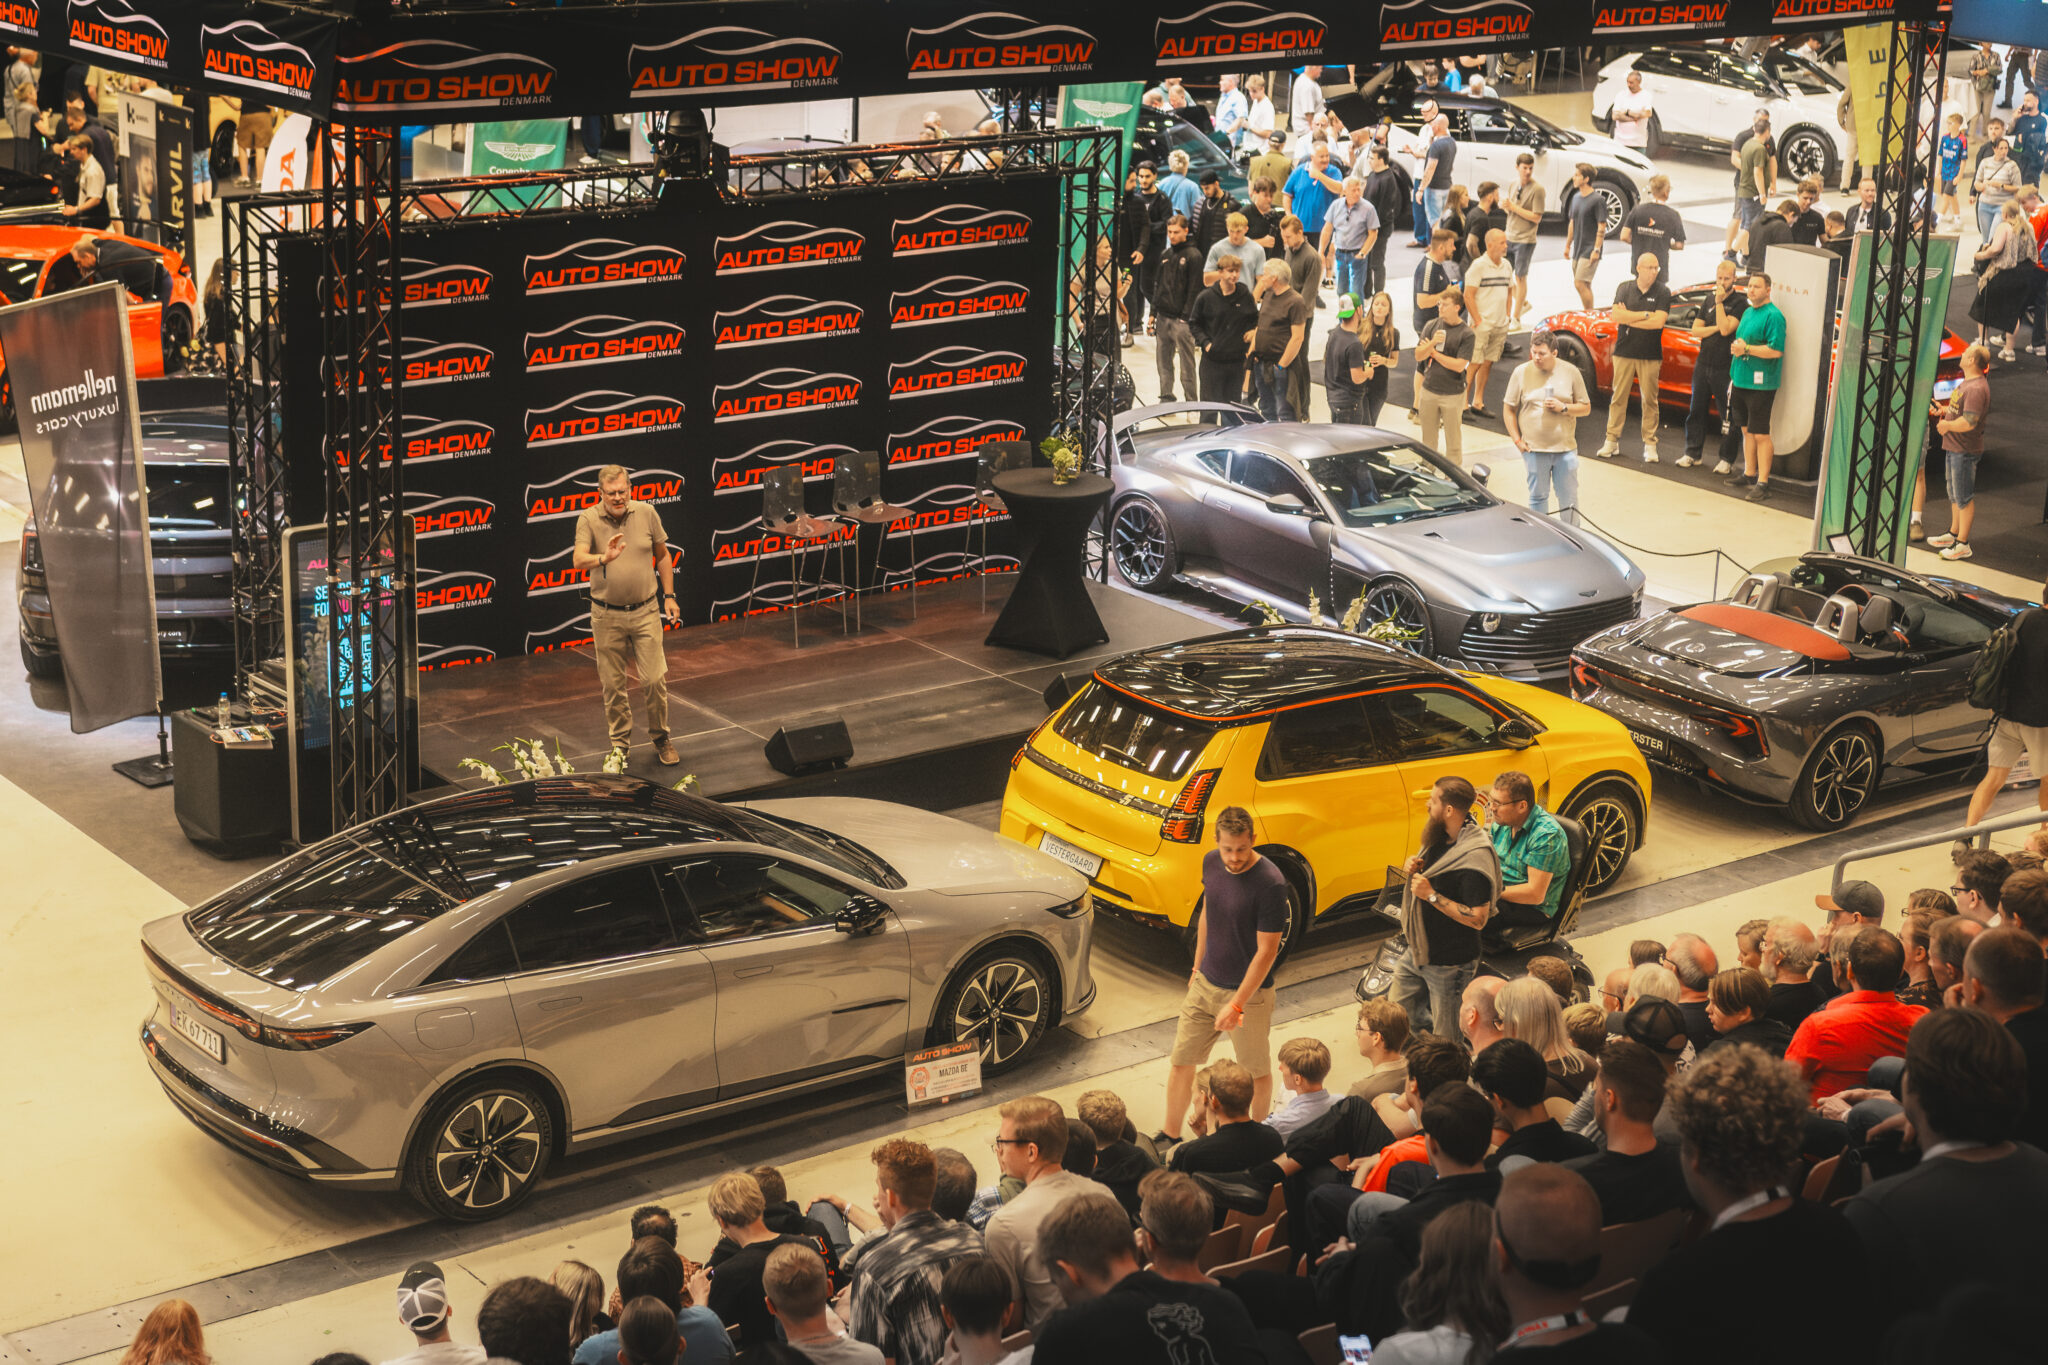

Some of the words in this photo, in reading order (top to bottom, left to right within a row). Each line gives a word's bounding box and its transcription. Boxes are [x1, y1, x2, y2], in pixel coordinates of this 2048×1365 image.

[1595, 8, 1656, 26] AUTO
[1659, 4, 1727, 23] SHOW
[1775, 0, 1831, 16] AUTO
[1382, 20, 1451, 42] AUTO
[1456, 14, 1531, 37] SHOW
[1695, 20, 1726, 30] DENMARK
[70, 19, 113, 47] AUTO
[116, 29, 167, 59] SHOW
[1159, 35, 1235, 57] AUTO
[1240, 29, 1324, 52] SHOW
[1496, 32, 1530, 42] DENMARK
[144, 56, 168, 69] DENMARK
[911, 47, 995, 70] AUTO
[1001, 43, 1093, 65] SHOW
[1287, 47, 1324, 57] DENMARK
[205, 49, 254, 77] AUTO
[256, 58, 314, 90] SHOW
[633, 64, 728, 88] AUTO
[734, 56, 838, 82] SHOW
[1052, 63, 1093, 73] DENMARK
[289, 86, 312, 100] DENMARK
[336, 79, 430, 102] AUTO
[438, 73, 551, 99] SHOW
[793, 77, 839, 88] DENMARK
[502, 95, 552, 106] DENMARK
[894, 230, 957, 250] AUTO
[960, 222, 1029, 243] SHOW
[717, 247, 784, 270] AUTO
[788, 240, 863, 262] SHOW
[829, 255, 862, 264] DENMARK
[528, 268, 599, 289] AUTO
[604, 257, 683, 280] SHOW
[647, 273, 683, 283] DENMARK
[405, 277, 490, 302] SHOW
[453, 293, 490, 304] DENMARK
[893, 301, 955, 323] AUTO
[958, 292, 1027, 314] SHOW
[716, 319, 783, 344] AUTO
[787, 312, 861, 335] SHOW
[827, 327, 860, 337] DENMARK
[528, 342, 599, 365] AUTO
[603, 332, 683, 356] SHOW
[647, 348, 682, 358] DENMARK
[406, 352, 492, 380] SHOW
[454, 371, 490, 382] DENMARK
[890, 371, 953, 394] AUTO
[956, 361, 1024, 384] SHOW
[716, 394, 782, 417] AUTO
[786, 384, 859, 408] SHOW
[826, 398, 859, 409] DENMARK
[528, 417, 600, 442] AUTO
[603, 406, 682, 431] SHOW
[647, 422, 682, 432] DENMARK
[407, 431, 492, 457] SHOW
[455, 447, 491, 459] DENMARK
[889, 441, 951, 464] AUTO
[716, 466, 781, 489] AUT
[629, 480, 682, 501] HOW
[414, 507, 492, 533] SHOW
[455, 523, 492, 535] DENMARK
[888, 509, 951, 533] AUTO
[715, 536, 782, 560] AUTO
[456, 597, 492, 609] DENMARK
[1045, 840, 1094, 872] VESTERGAARD
[189, 1020, 200, 1041] 67
[202, 1028, 218, 1055] 711
[912, 1049, 940, 1062] AUTO
[941, 1042, 972, 1056] SHOW
[939, 1065, 960, 1077] MAZDA
